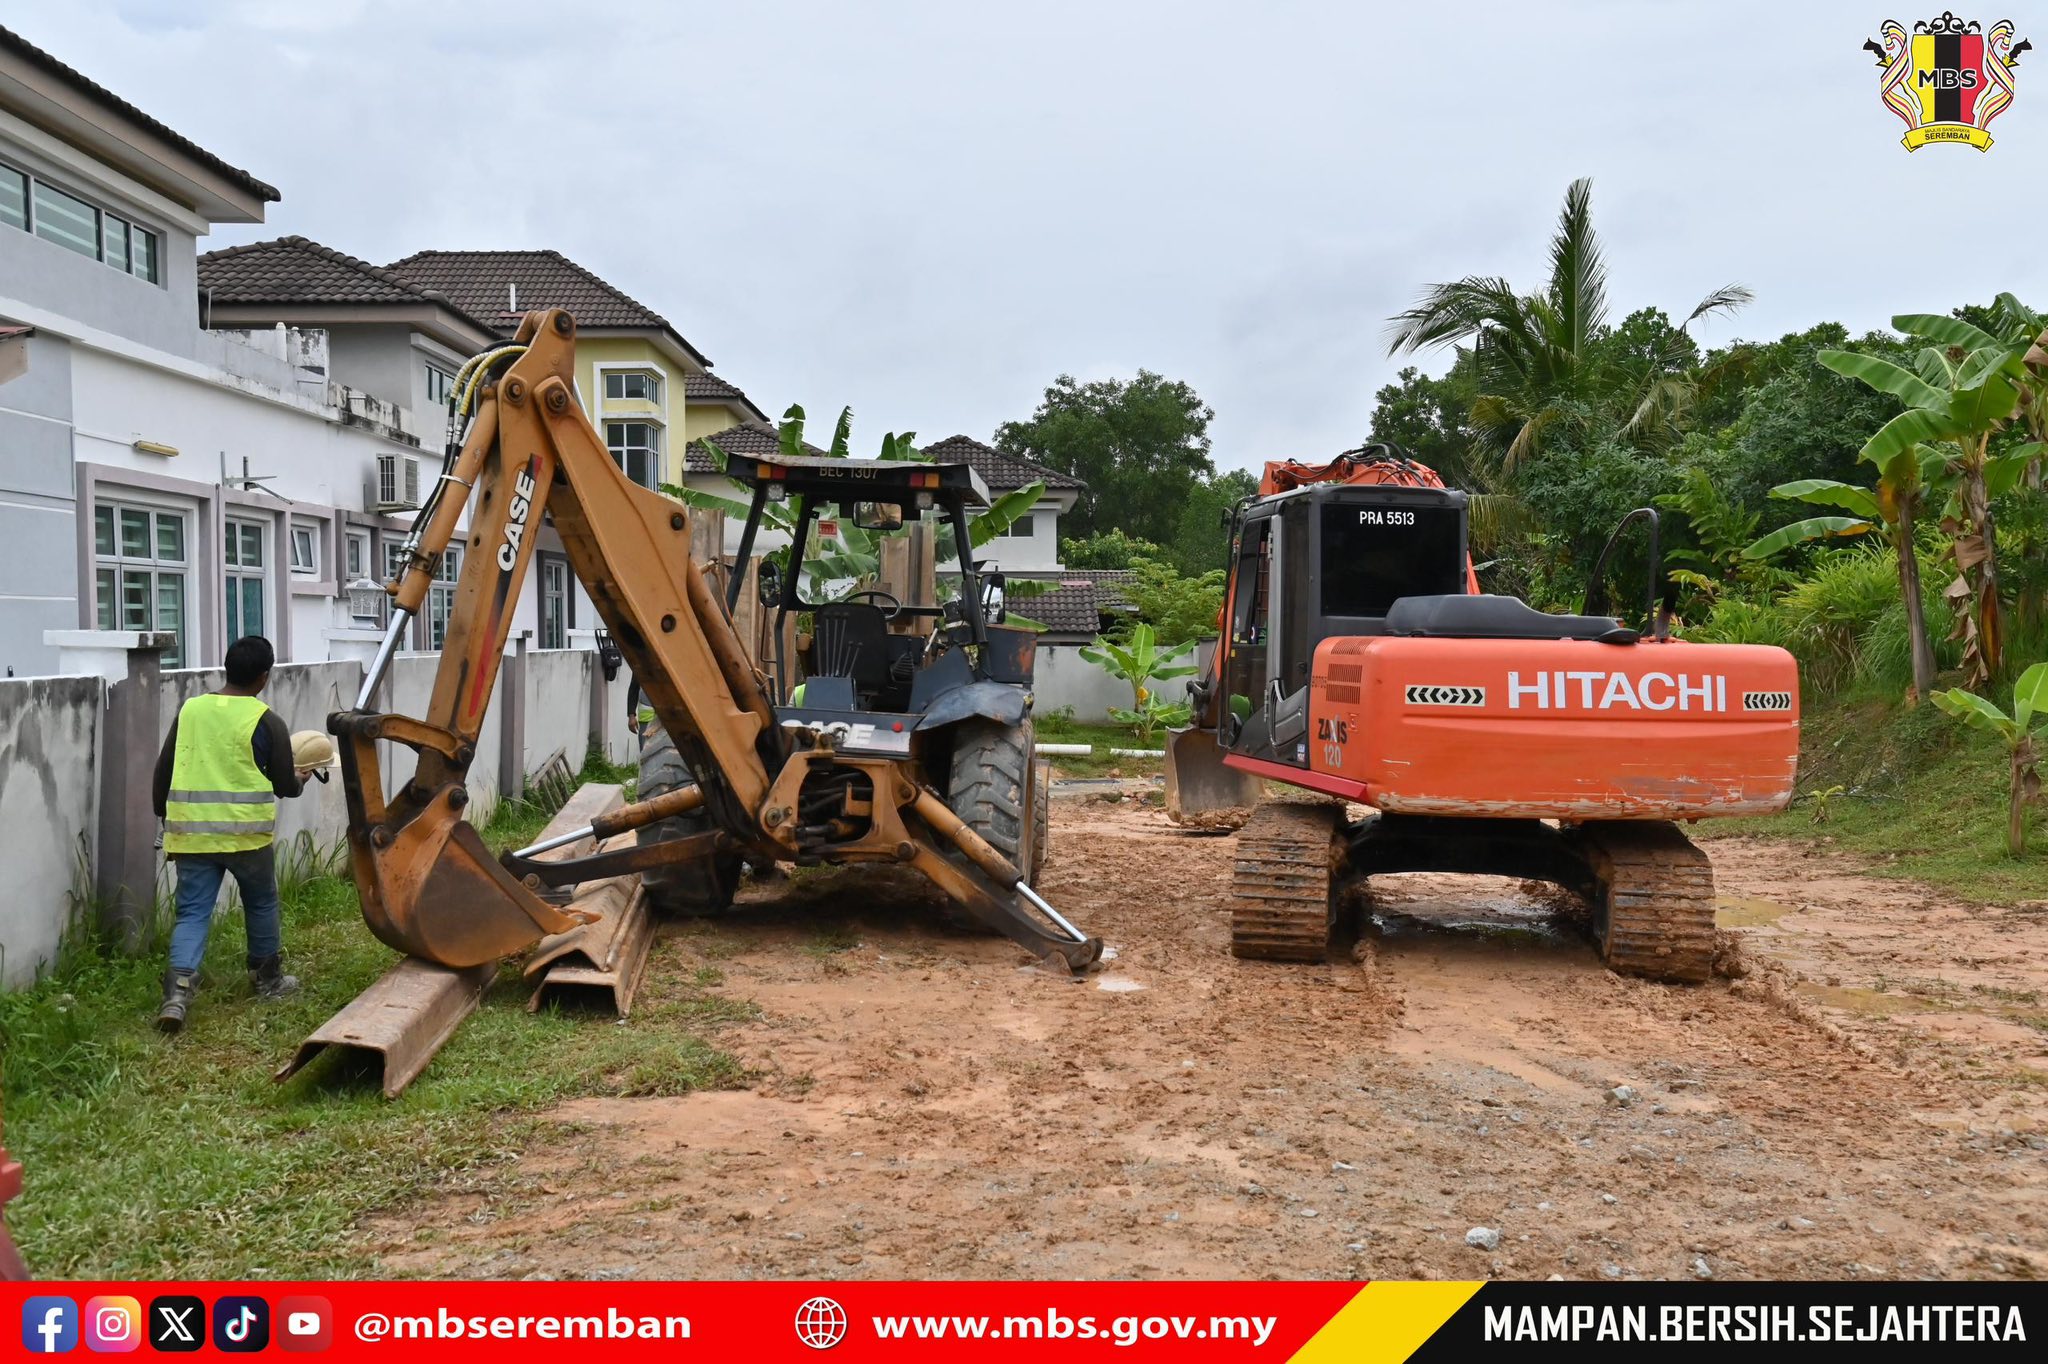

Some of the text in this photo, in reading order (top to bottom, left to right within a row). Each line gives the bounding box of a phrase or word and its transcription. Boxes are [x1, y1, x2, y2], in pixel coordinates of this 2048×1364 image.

[850, 467, 879, 479] 1307
[497, 470, 536, 572] CASE
[1360, 511, 1415, 526] PRA 5513
[1508, 671, 1726, 712] HITACHI
[1318, 715, 1348, 744] ZAXIS
[1323, 743, 1342, 768] 120
